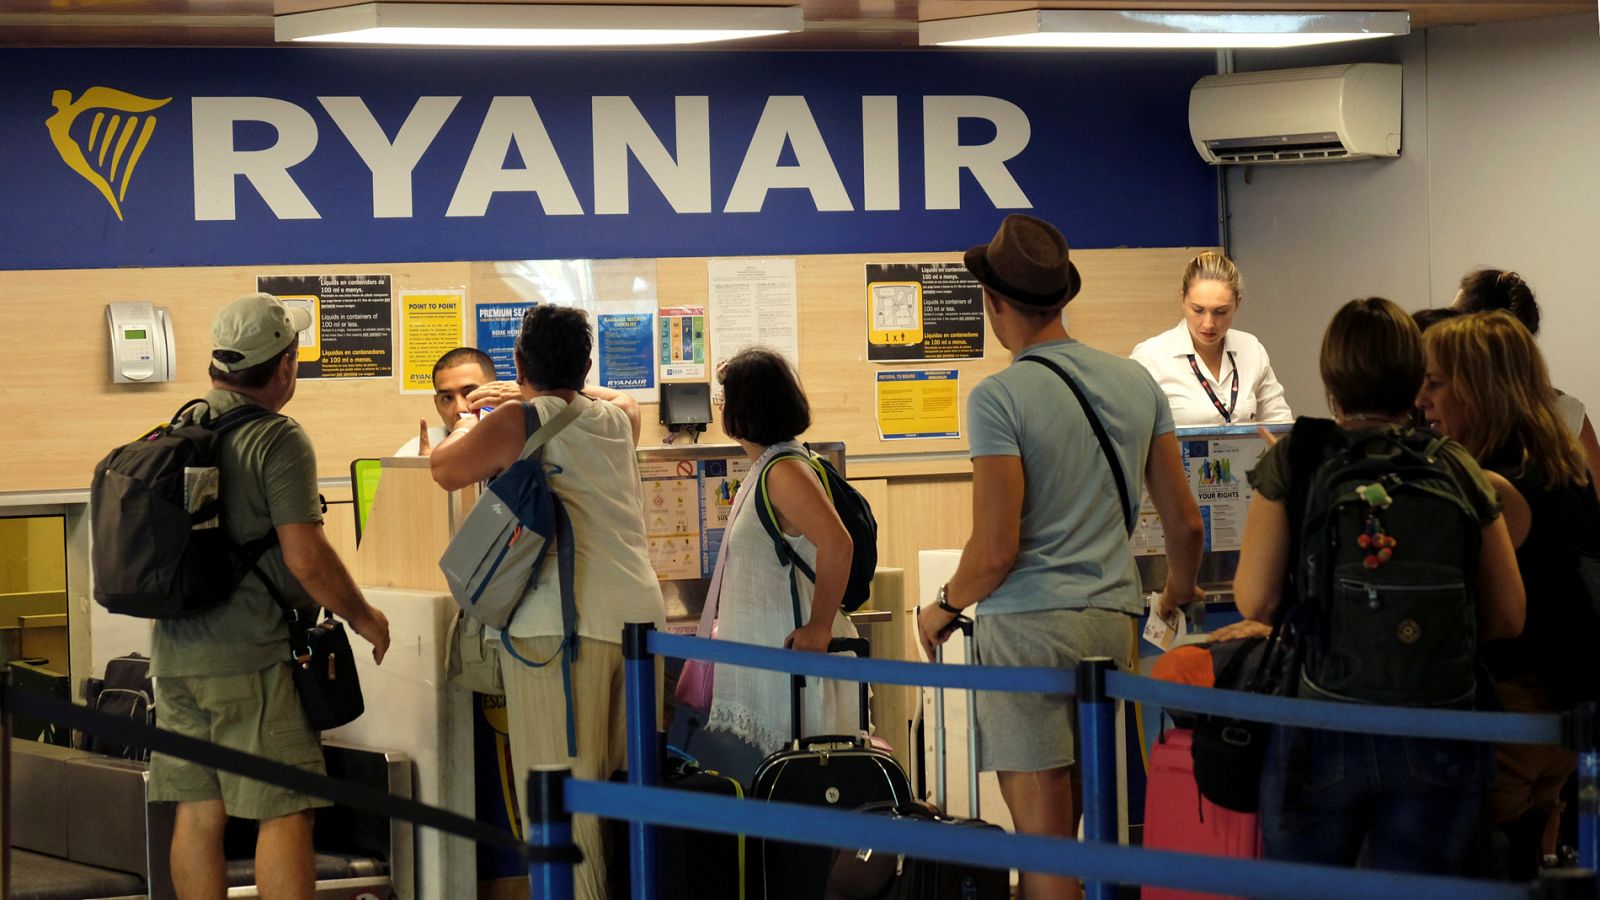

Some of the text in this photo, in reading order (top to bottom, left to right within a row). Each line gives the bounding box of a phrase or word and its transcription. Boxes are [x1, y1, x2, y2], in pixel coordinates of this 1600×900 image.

[192, 96, 1033, 220] RYANAIR
[480, 309, 512, 317] PREMIUM
[885, 333, 889, 342] 1
